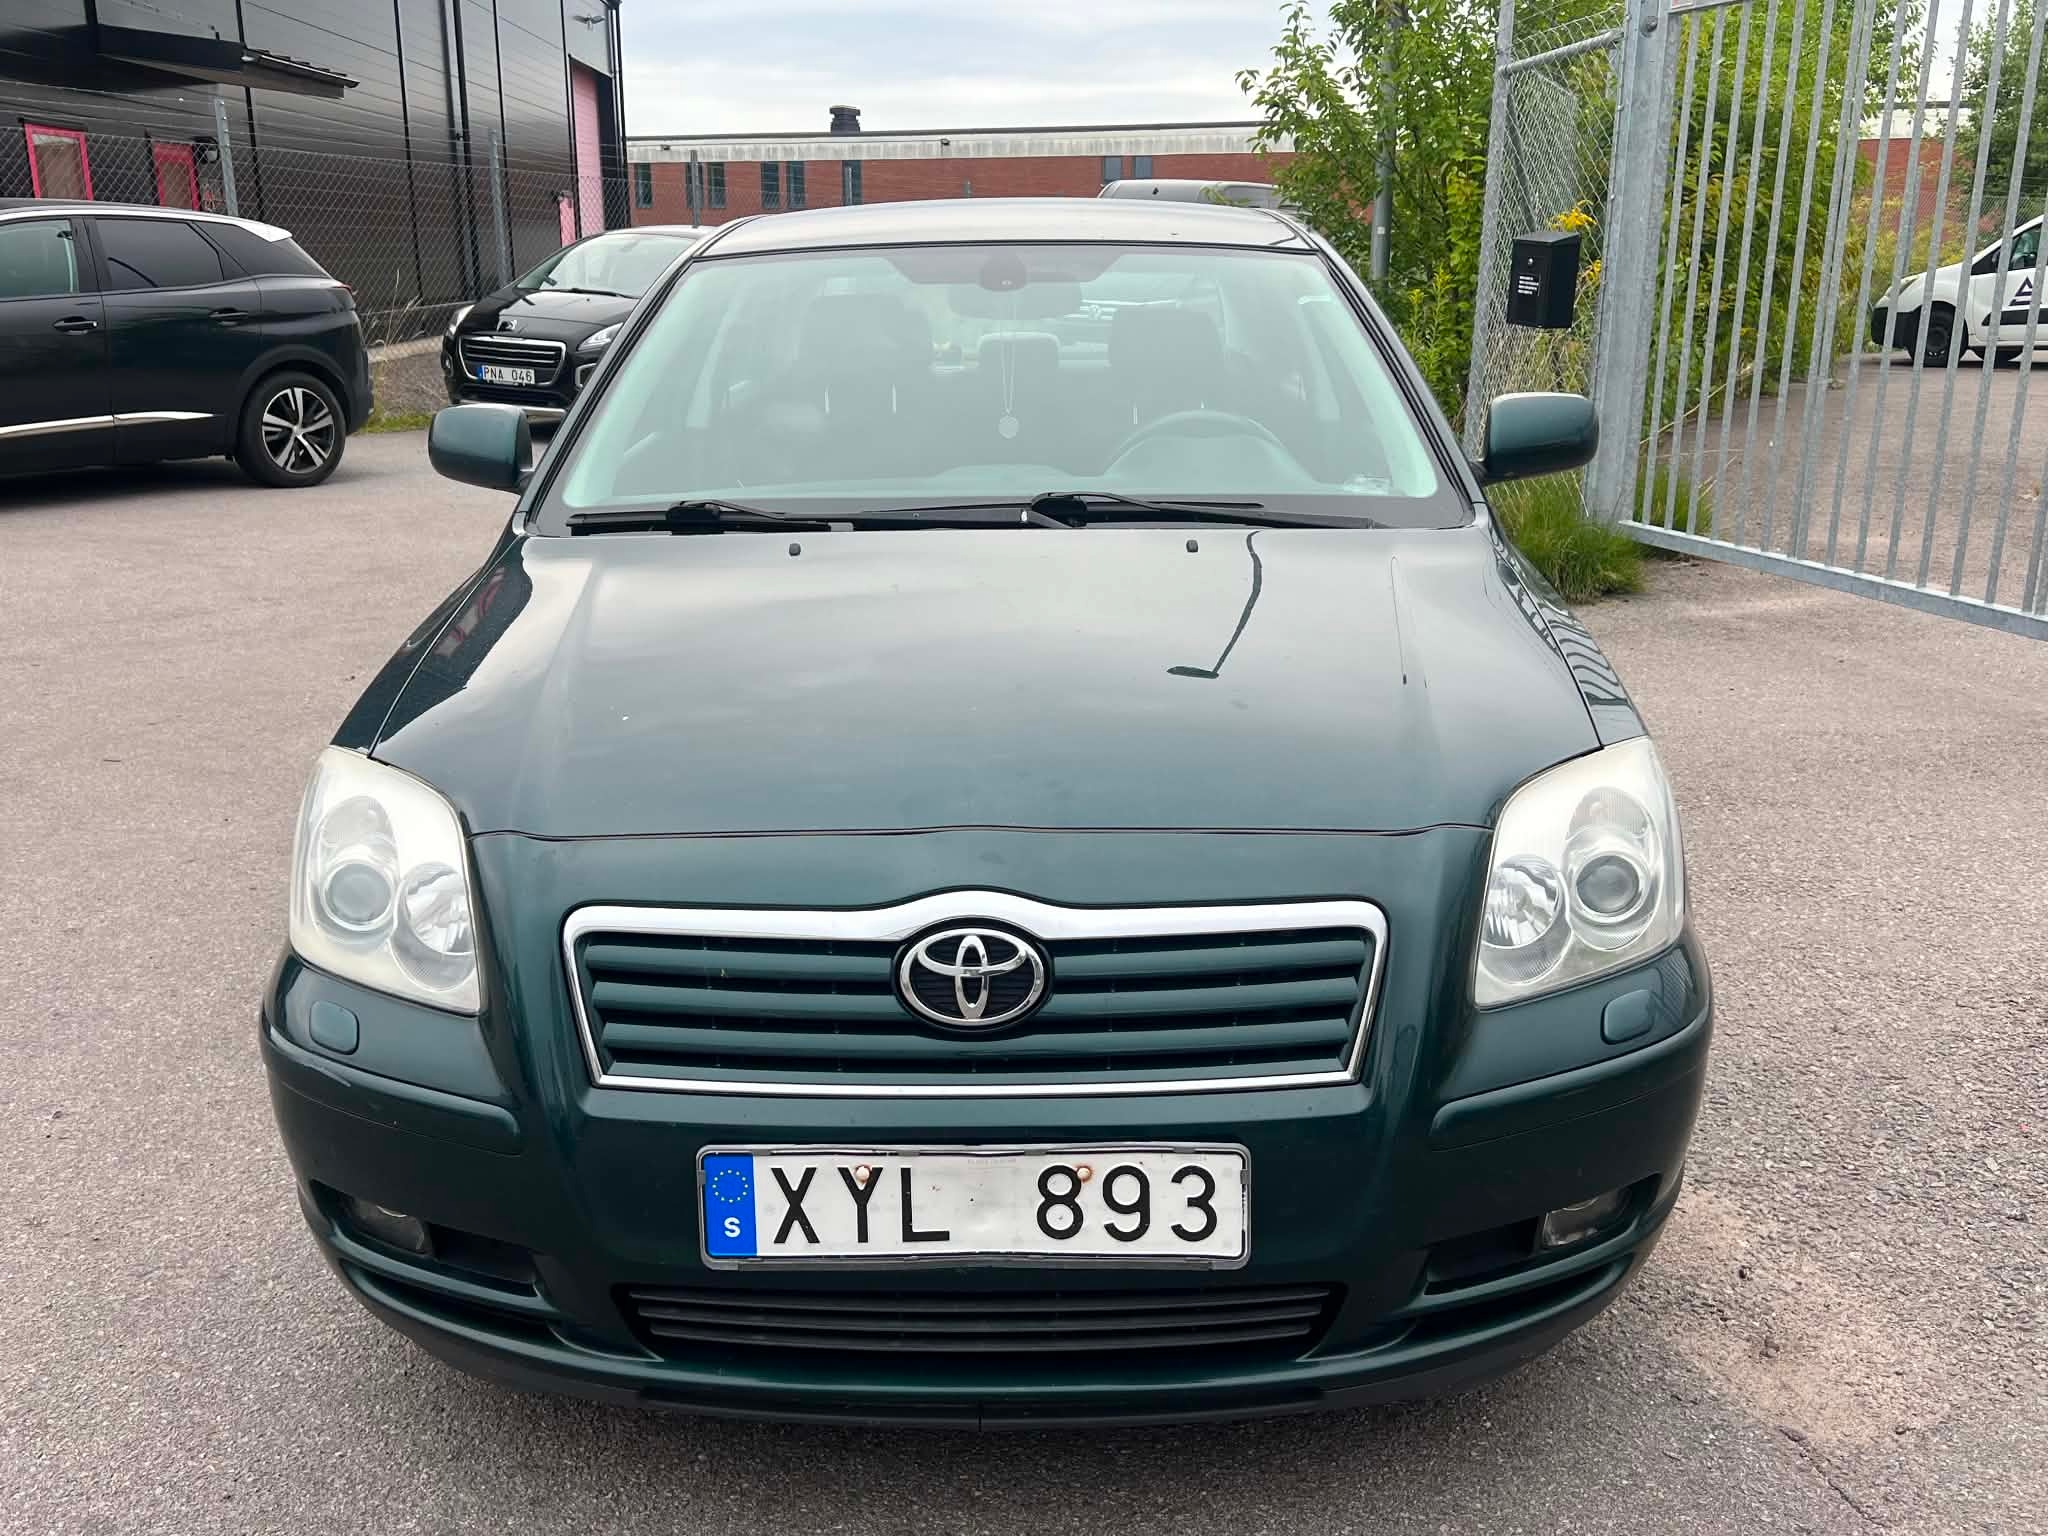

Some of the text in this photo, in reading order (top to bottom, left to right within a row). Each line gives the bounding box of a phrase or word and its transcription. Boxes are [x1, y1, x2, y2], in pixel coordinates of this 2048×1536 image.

[483, 366, 532, 383] PNA 046
[770, 1165, 1218, 1244] XYL 893
[724, 1217, 741, 1238] S
